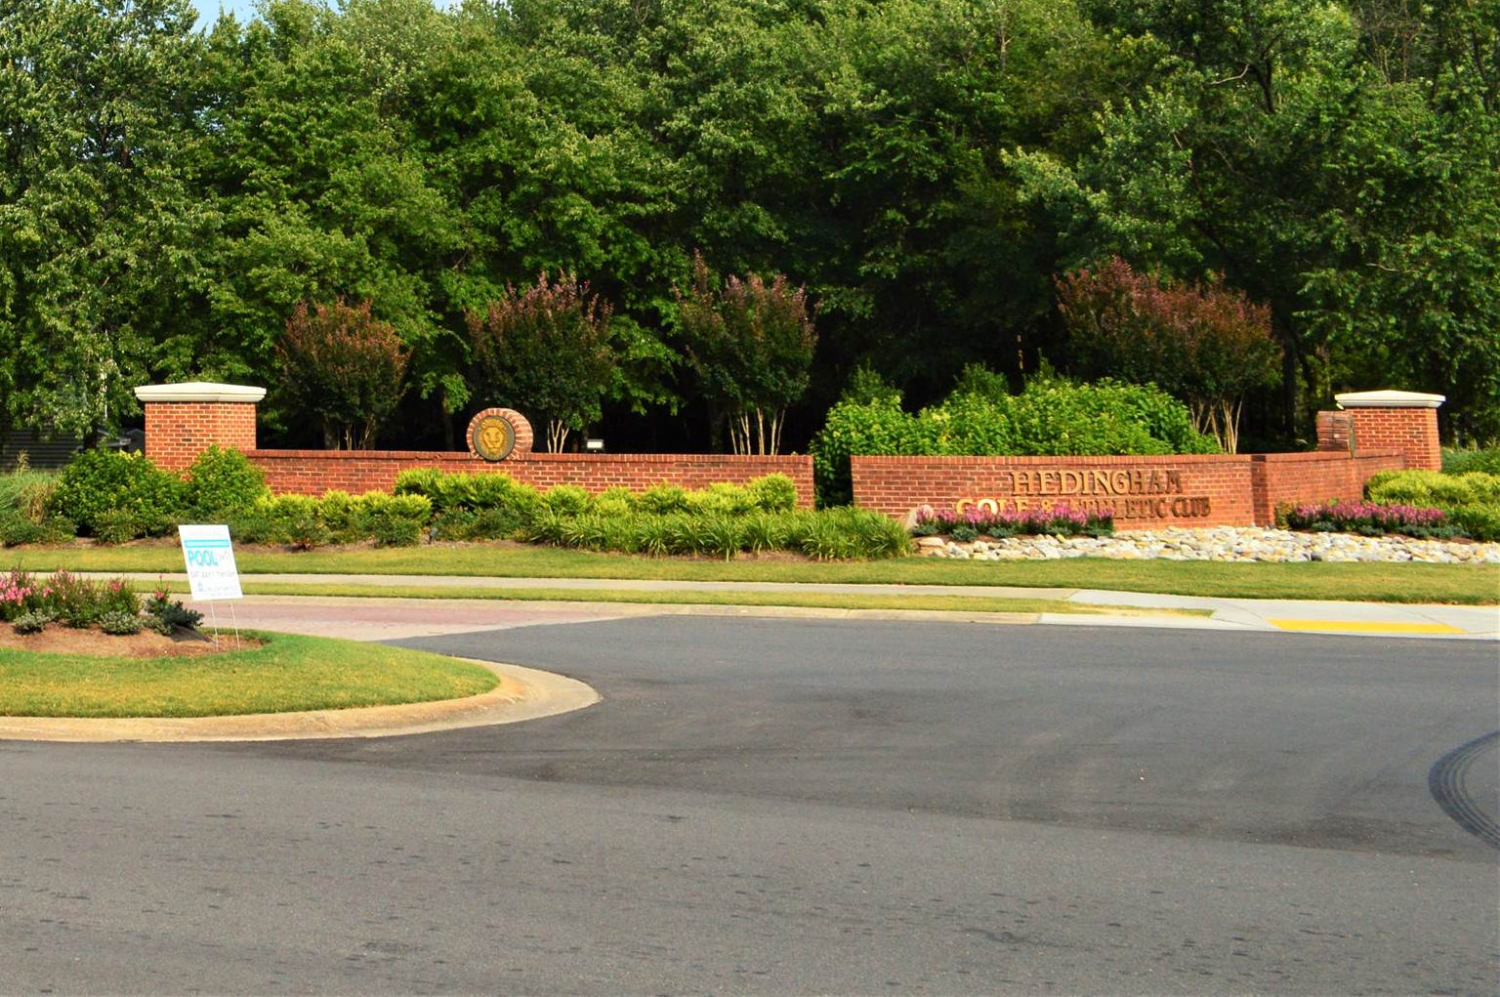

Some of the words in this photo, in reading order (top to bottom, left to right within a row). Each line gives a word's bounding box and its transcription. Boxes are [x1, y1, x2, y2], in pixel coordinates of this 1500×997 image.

[1011, 469, 1183, 496] HEDINGHAM
[1171, 497, 1211, 518] CLUB
[187, 550, 219, 567] POOL
